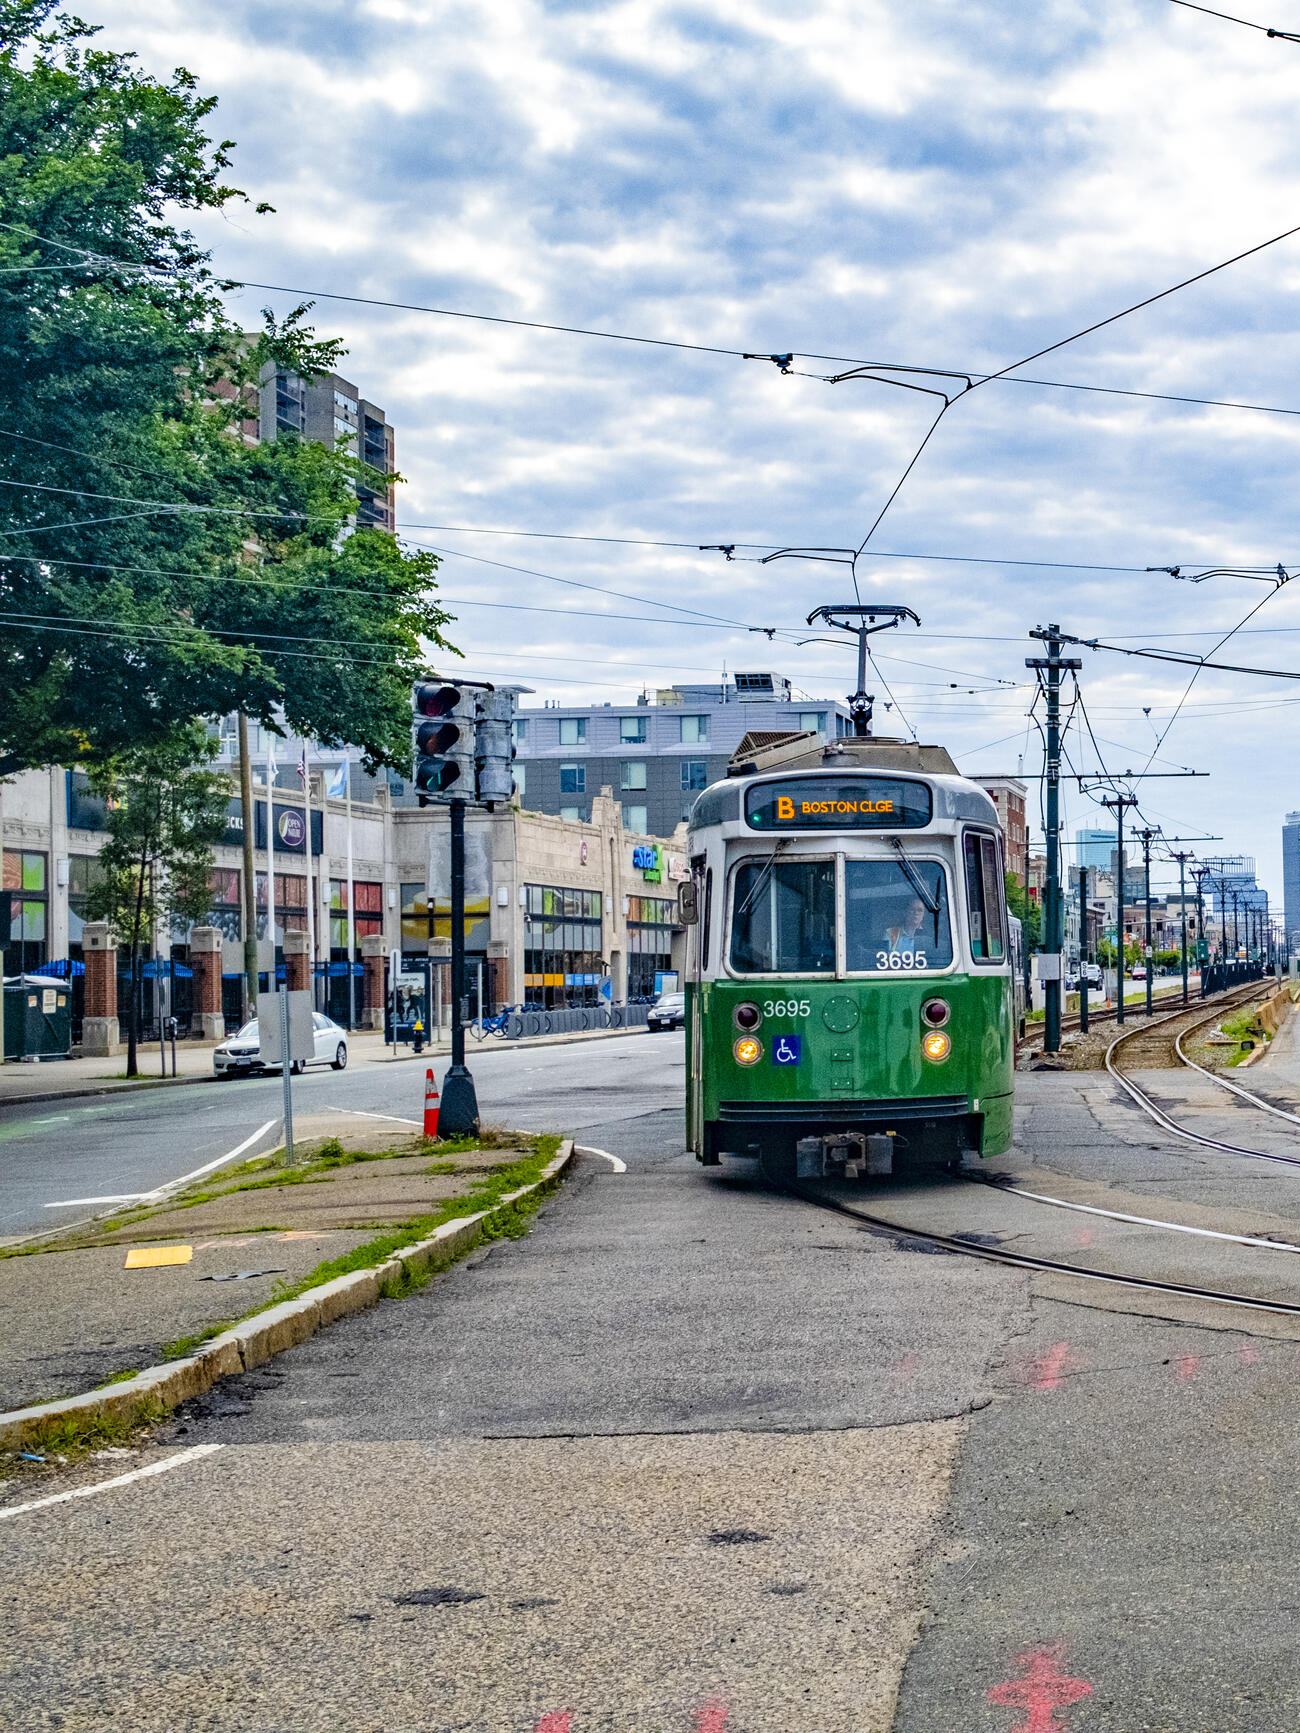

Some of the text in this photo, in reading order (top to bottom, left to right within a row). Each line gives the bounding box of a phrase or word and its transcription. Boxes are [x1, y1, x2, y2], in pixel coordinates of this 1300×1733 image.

[777, 796, 893, 819] B BOSTON CLGE
[876, 951, 927, 970] 3695
[763, 1000, 811, 1018] 3695
